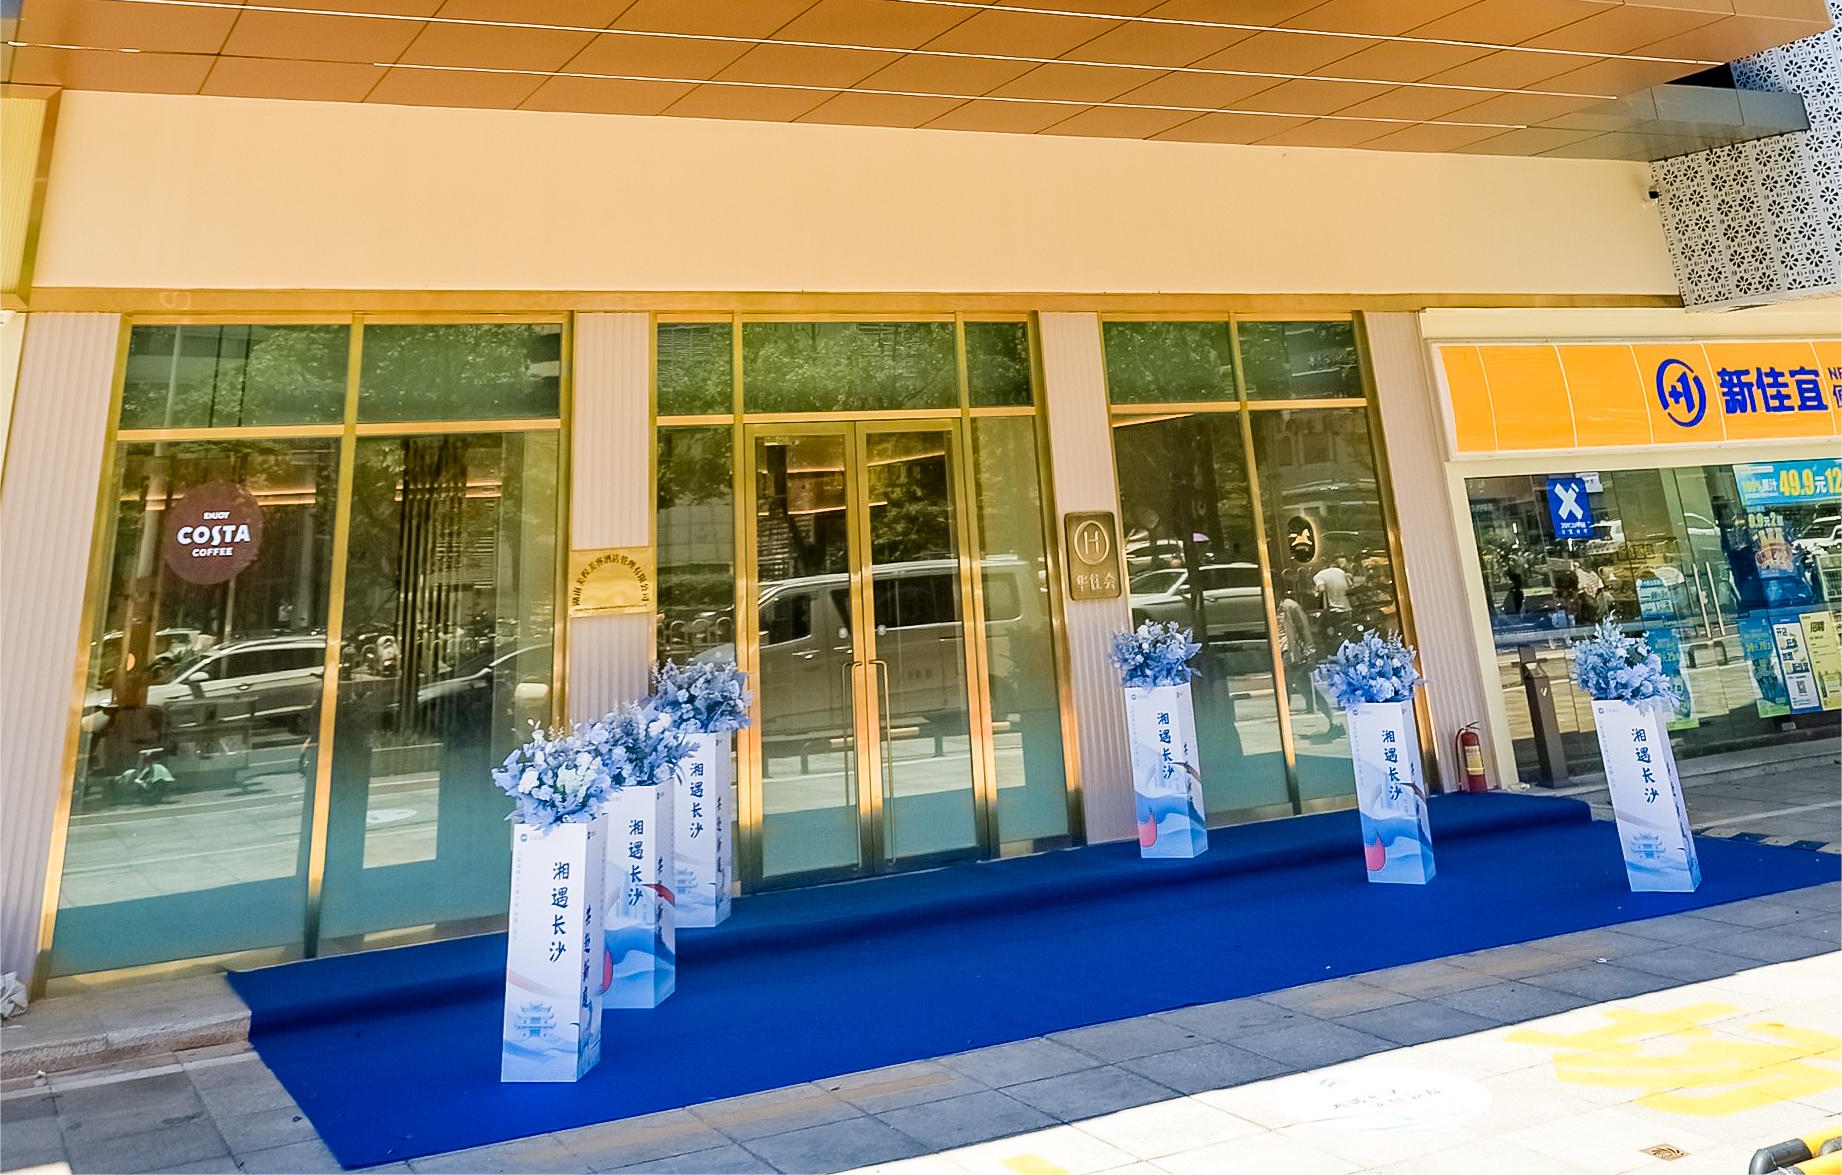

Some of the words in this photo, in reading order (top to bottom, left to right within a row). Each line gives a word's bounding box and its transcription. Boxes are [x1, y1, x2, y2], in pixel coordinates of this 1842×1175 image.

[1717, 366, 1828, 414] 新佳宜
[177, 524, 251, 546] COSTA
[203, 511, 230, 520] ENJOY
[192, 547, 233, 557] COFFEE
[1077, 572, 1116, 591] 华住会
[1157, 712, 1175, 780] 湘遇长沙
[1381, 730, 1403, 801] 湘遇长沙
[1631, 728, 1660, 804] 湘遇长沙
[689, 762, 704, 839] 湘遇长沙
[628, 819, 645, 906] 湘遇长沙
[549, 861, 570, 963] 湘遇长沙
